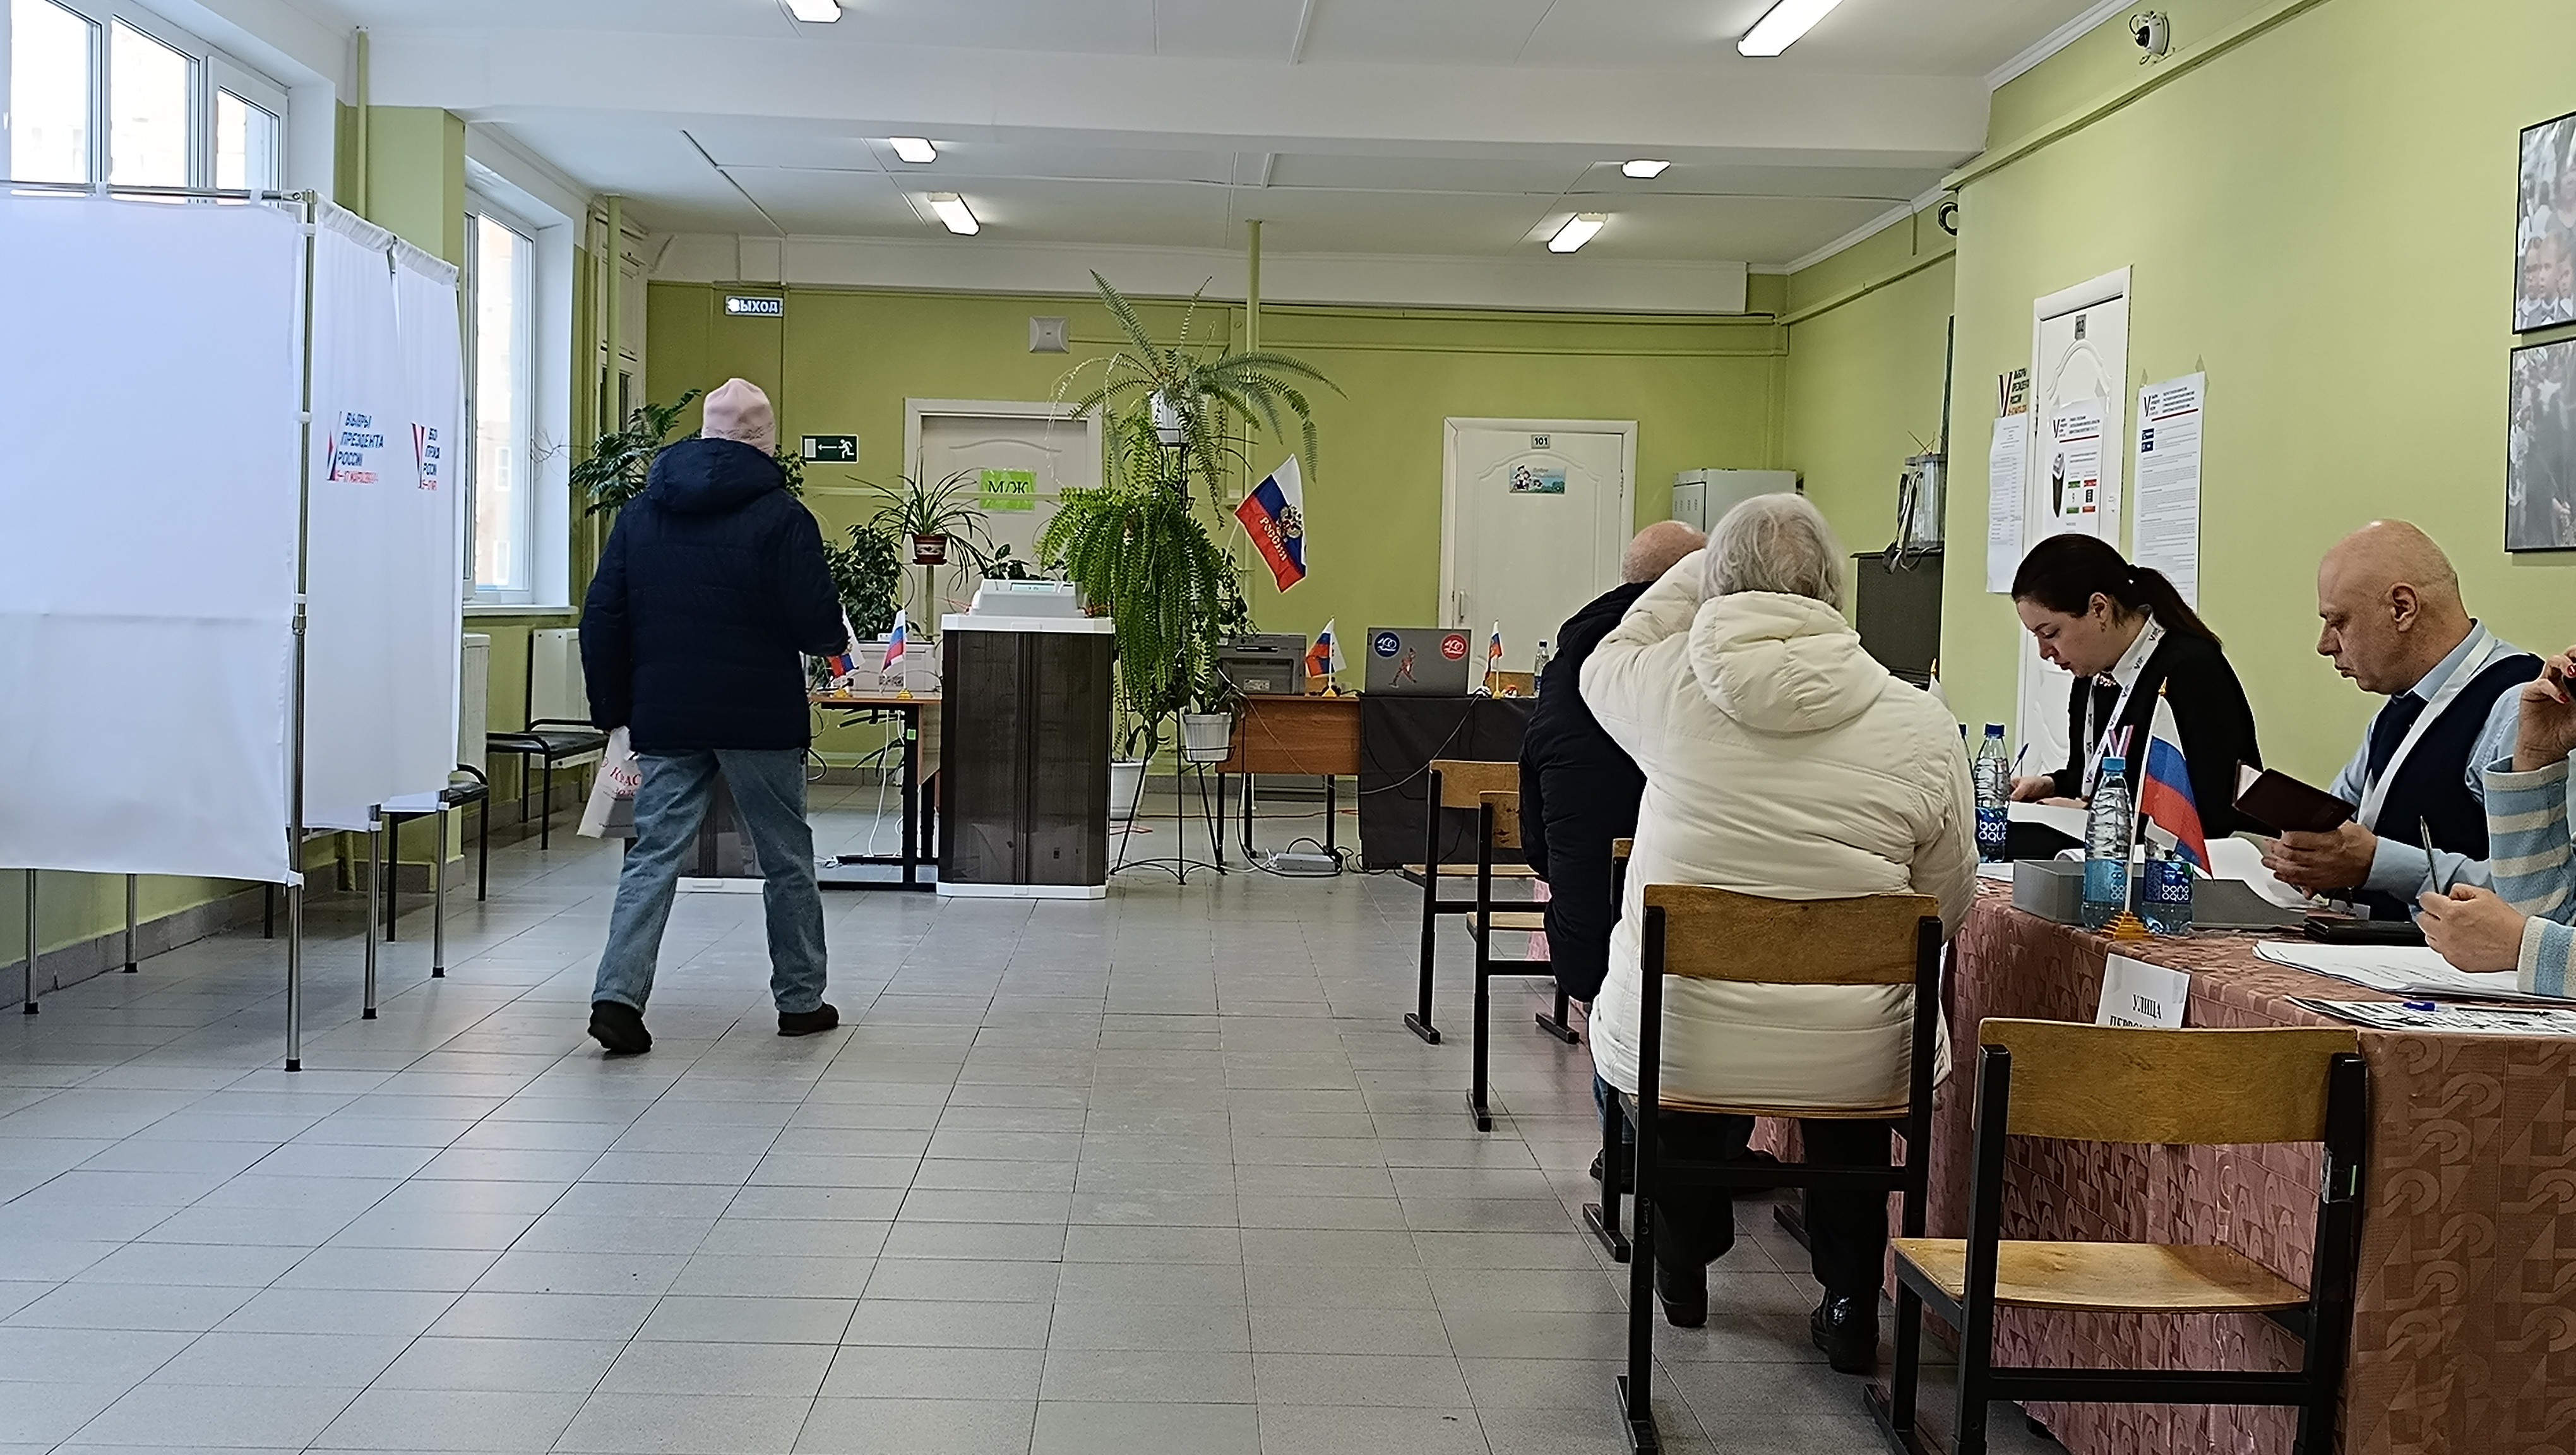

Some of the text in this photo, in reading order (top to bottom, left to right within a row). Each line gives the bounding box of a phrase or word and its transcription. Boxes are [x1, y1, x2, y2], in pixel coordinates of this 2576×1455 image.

[1534, 437, 1548, 445] 101
[1260, 517, 1287, 561] РОССИЯ
[2133, 993, 2162, 1019] УЛИЦА
